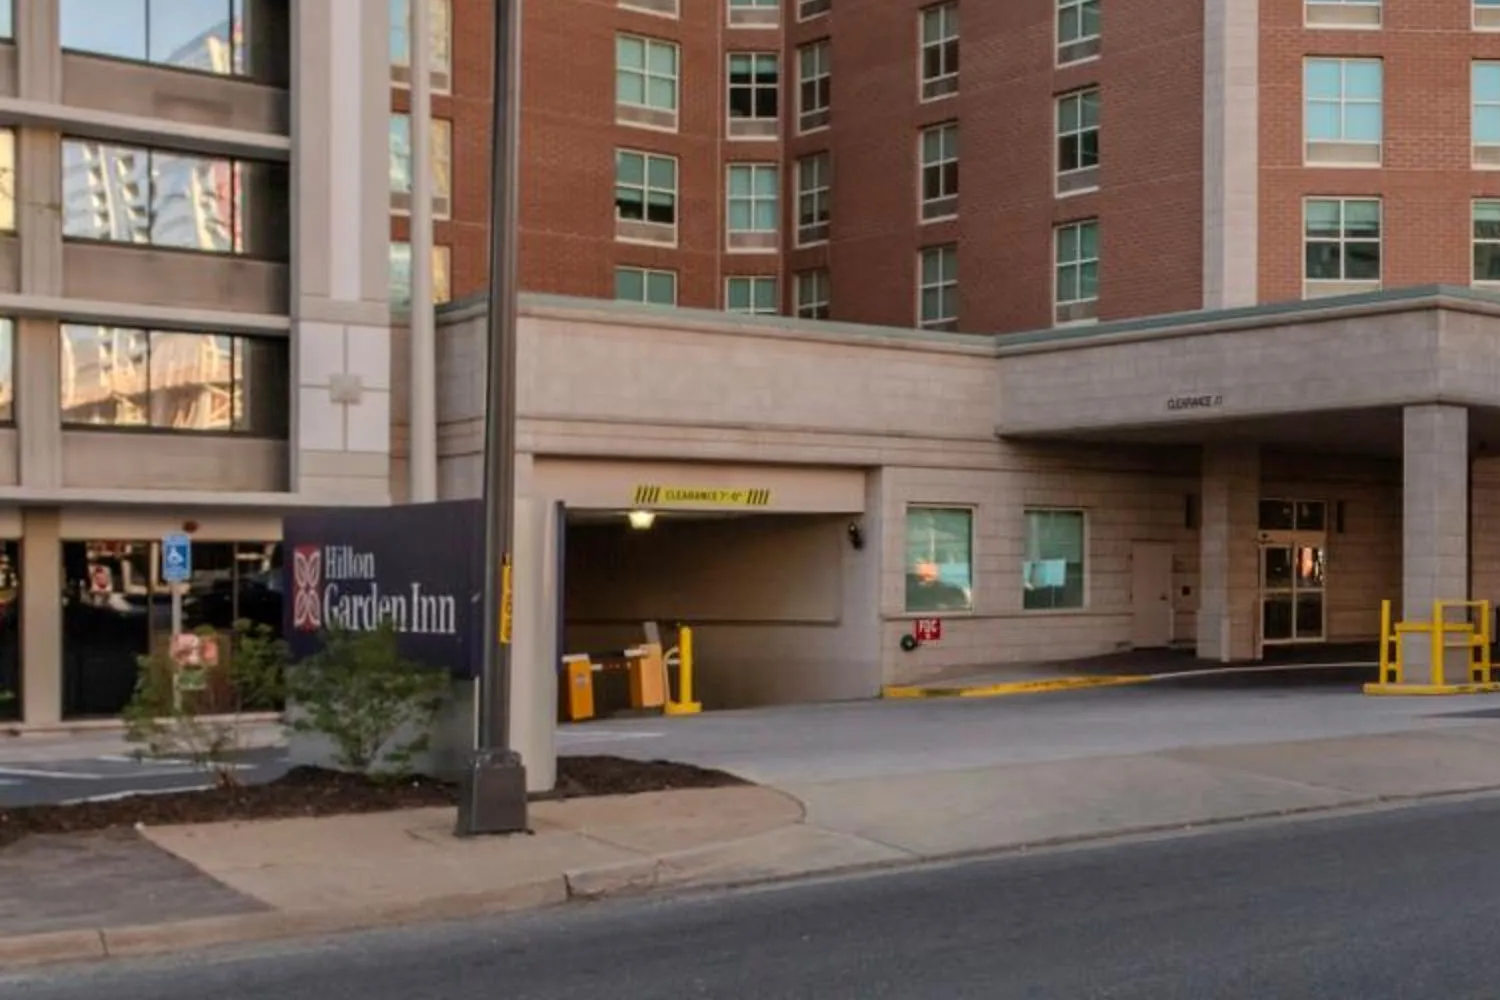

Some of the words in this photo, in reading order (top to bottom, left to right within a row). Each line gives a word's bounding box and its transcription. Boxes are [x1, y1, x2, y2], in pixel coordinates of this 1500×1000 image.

[324, 546, 376, 579] Hilton
[323, 583, 407, 632] Garden
[410, 582, 456, 634] Inn
